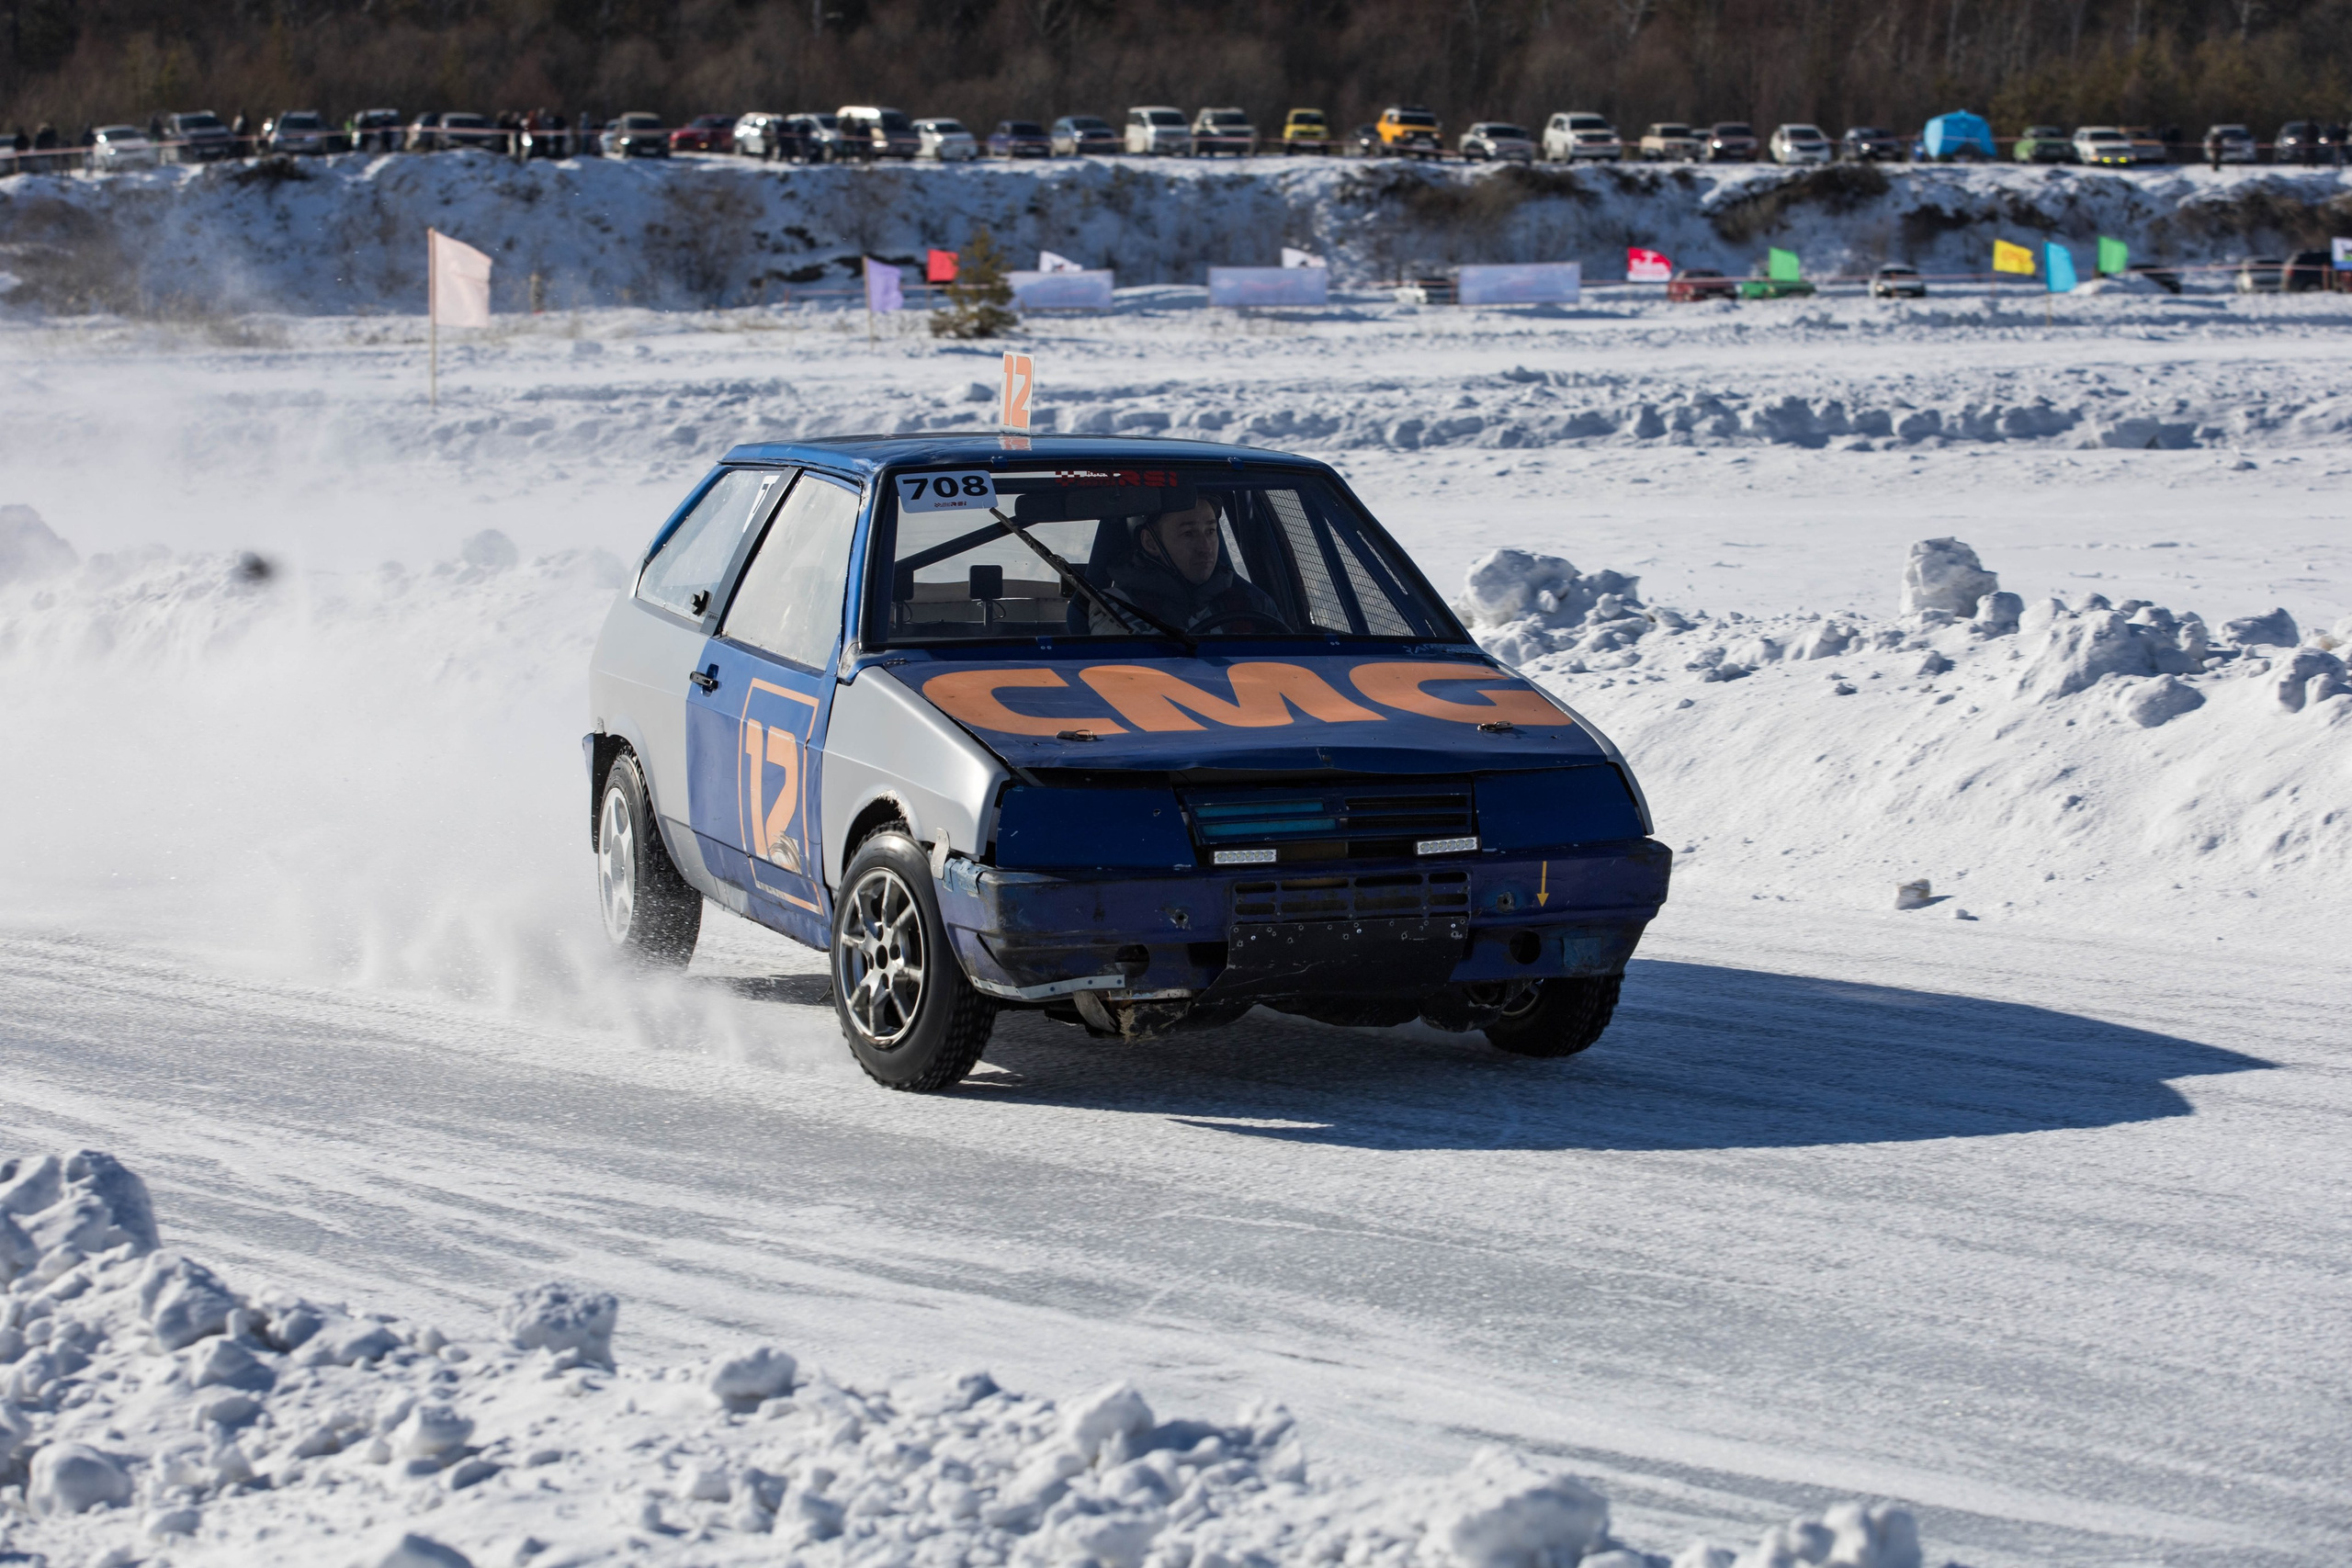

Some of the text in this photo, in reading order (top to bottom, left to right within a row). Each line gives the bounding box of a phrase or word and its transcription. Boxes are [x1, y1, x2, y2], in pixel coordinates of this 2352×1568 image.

[1003, 354, 1032, 429] 12
[902, 475, 989, 501] 708
[922, 661, 1573, 735] CMG
[745, 717, 802, 874] 12
